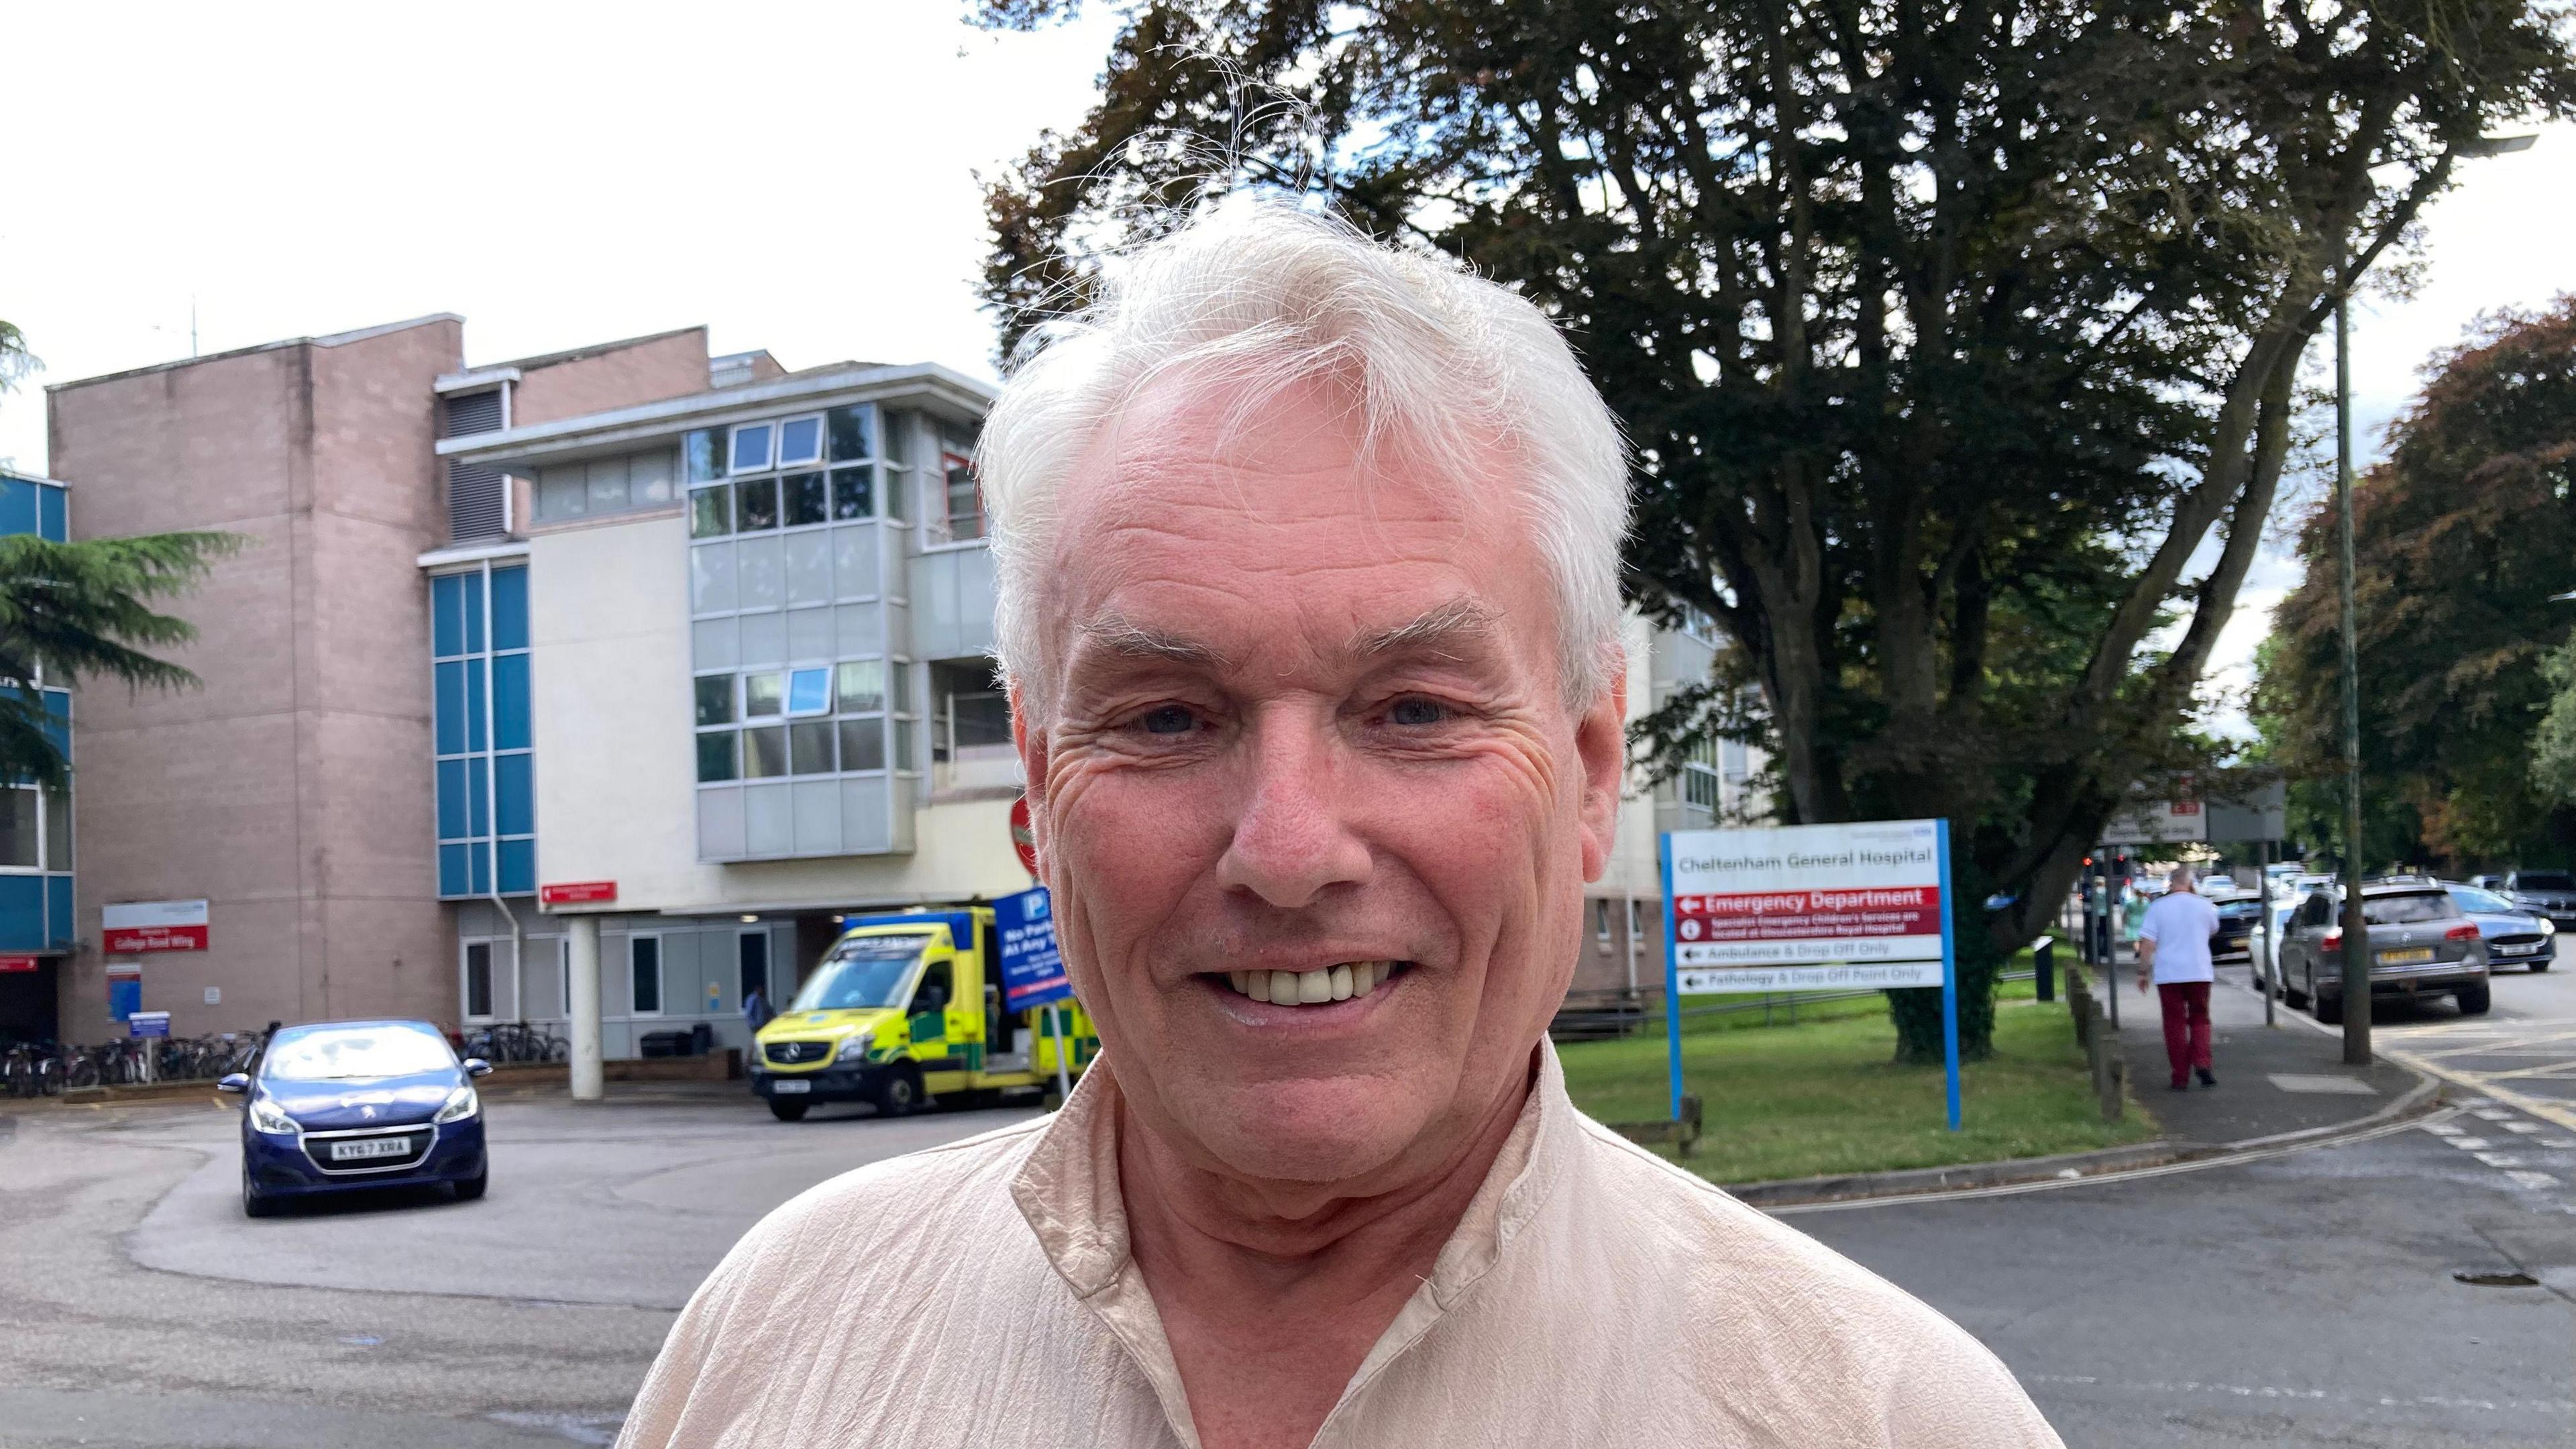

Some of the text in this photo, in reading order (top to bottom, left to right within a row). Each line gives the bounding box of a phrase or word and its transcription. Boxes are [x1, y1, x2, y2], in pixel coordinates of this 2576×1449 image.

[1679, 847, 1931, 874] Cheltenham General Hospital
[1705, 888, 1923, 915] Emergency Department
[1708, 941, 1889, 959] Ambulance & Drop Off Only
[1709, 973, 1773, 987] Pathology
[1792, 970, 1823, 983] Drop
[1828, 968, 1850, 981] Off
[1853, 968, 1886, 981] Point
[1891, 967, 1922, 981] Only
